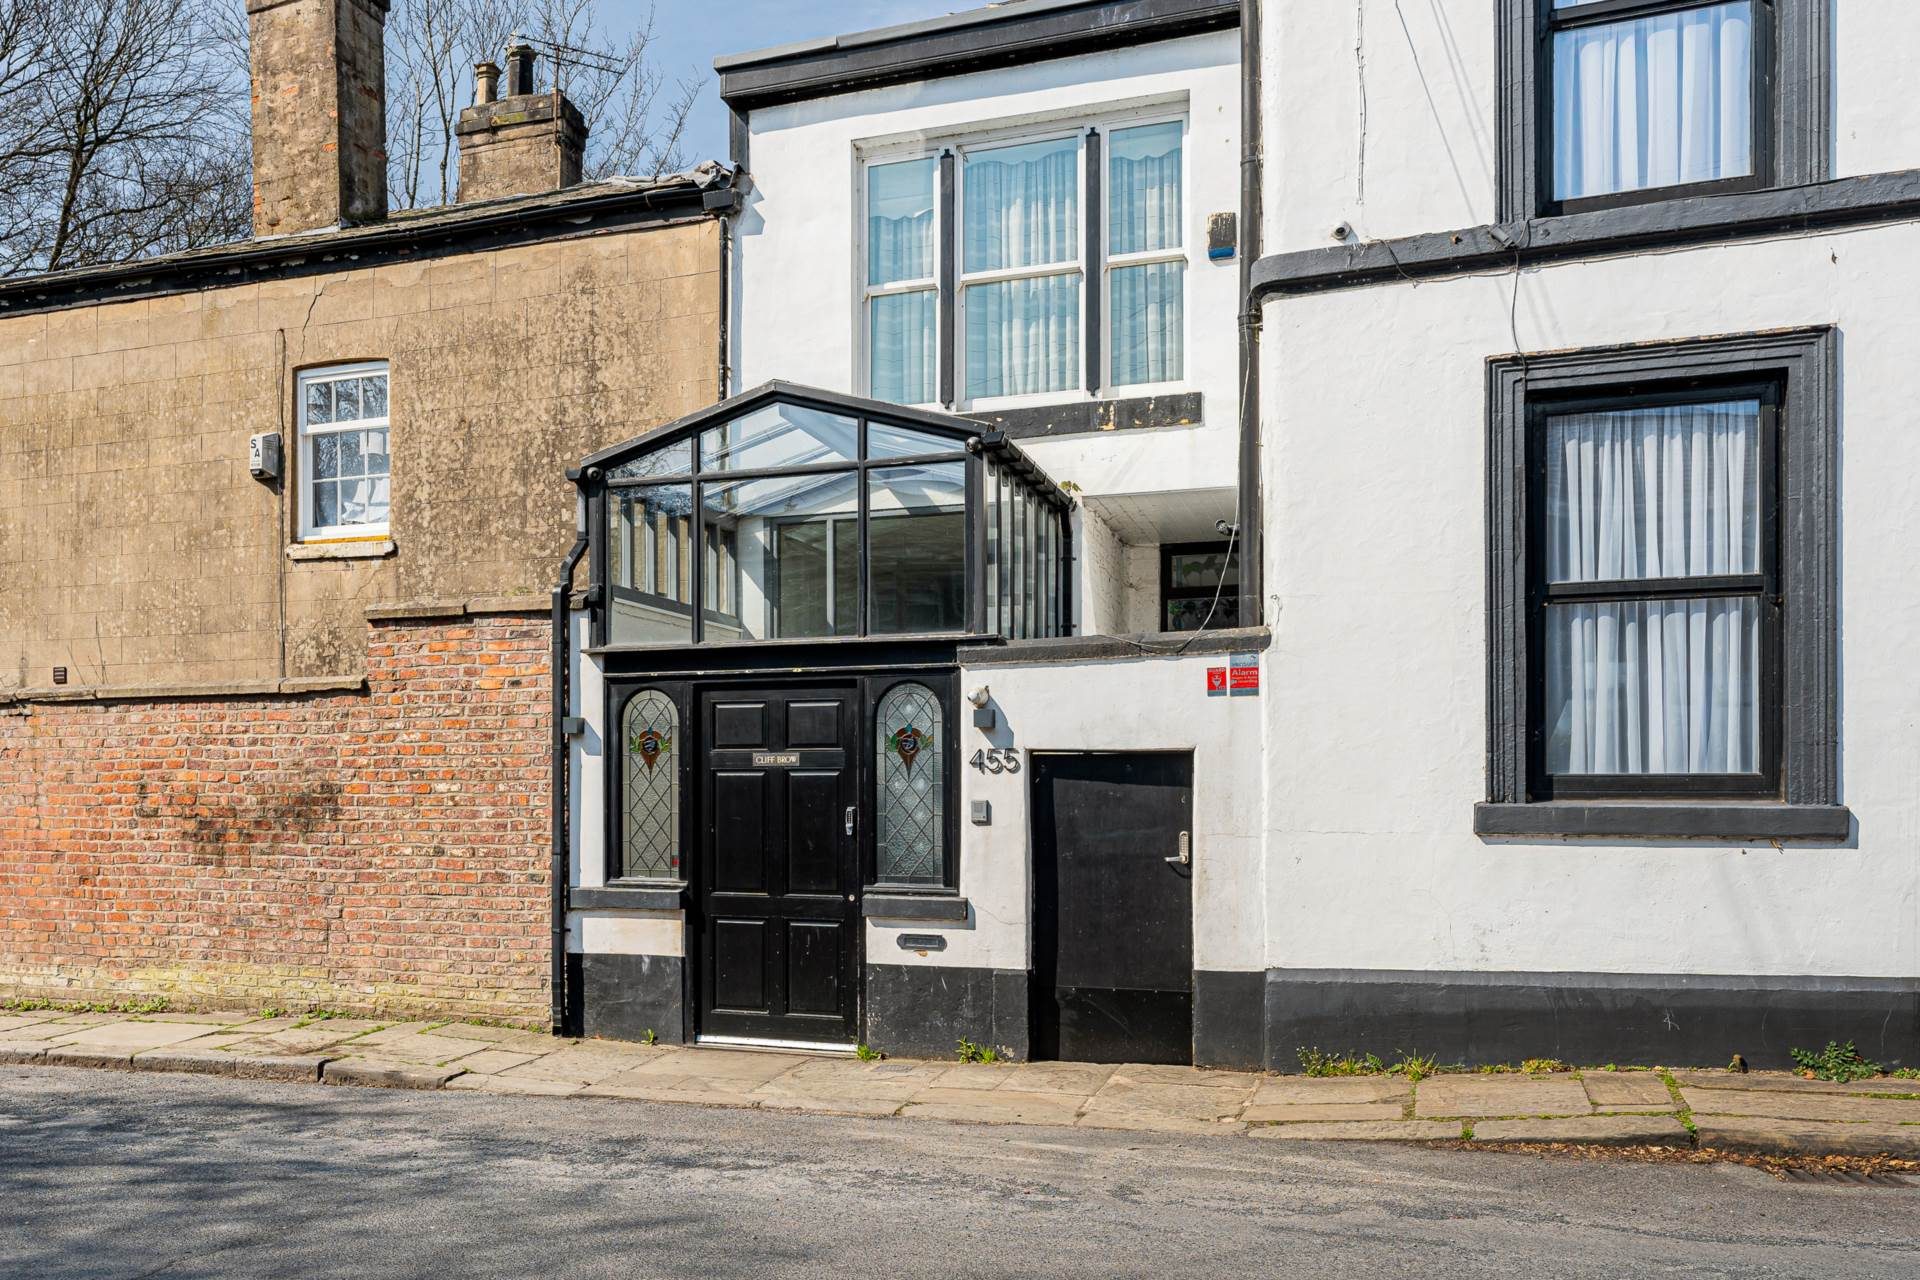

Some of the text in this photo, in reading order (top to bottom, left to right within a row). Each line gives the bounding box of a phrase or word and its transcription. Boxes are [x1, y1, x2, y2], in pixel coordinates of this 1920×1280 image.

[755, 755, 797, 764] CLIFF BROW
[969, 748, 1021, 774] 455
